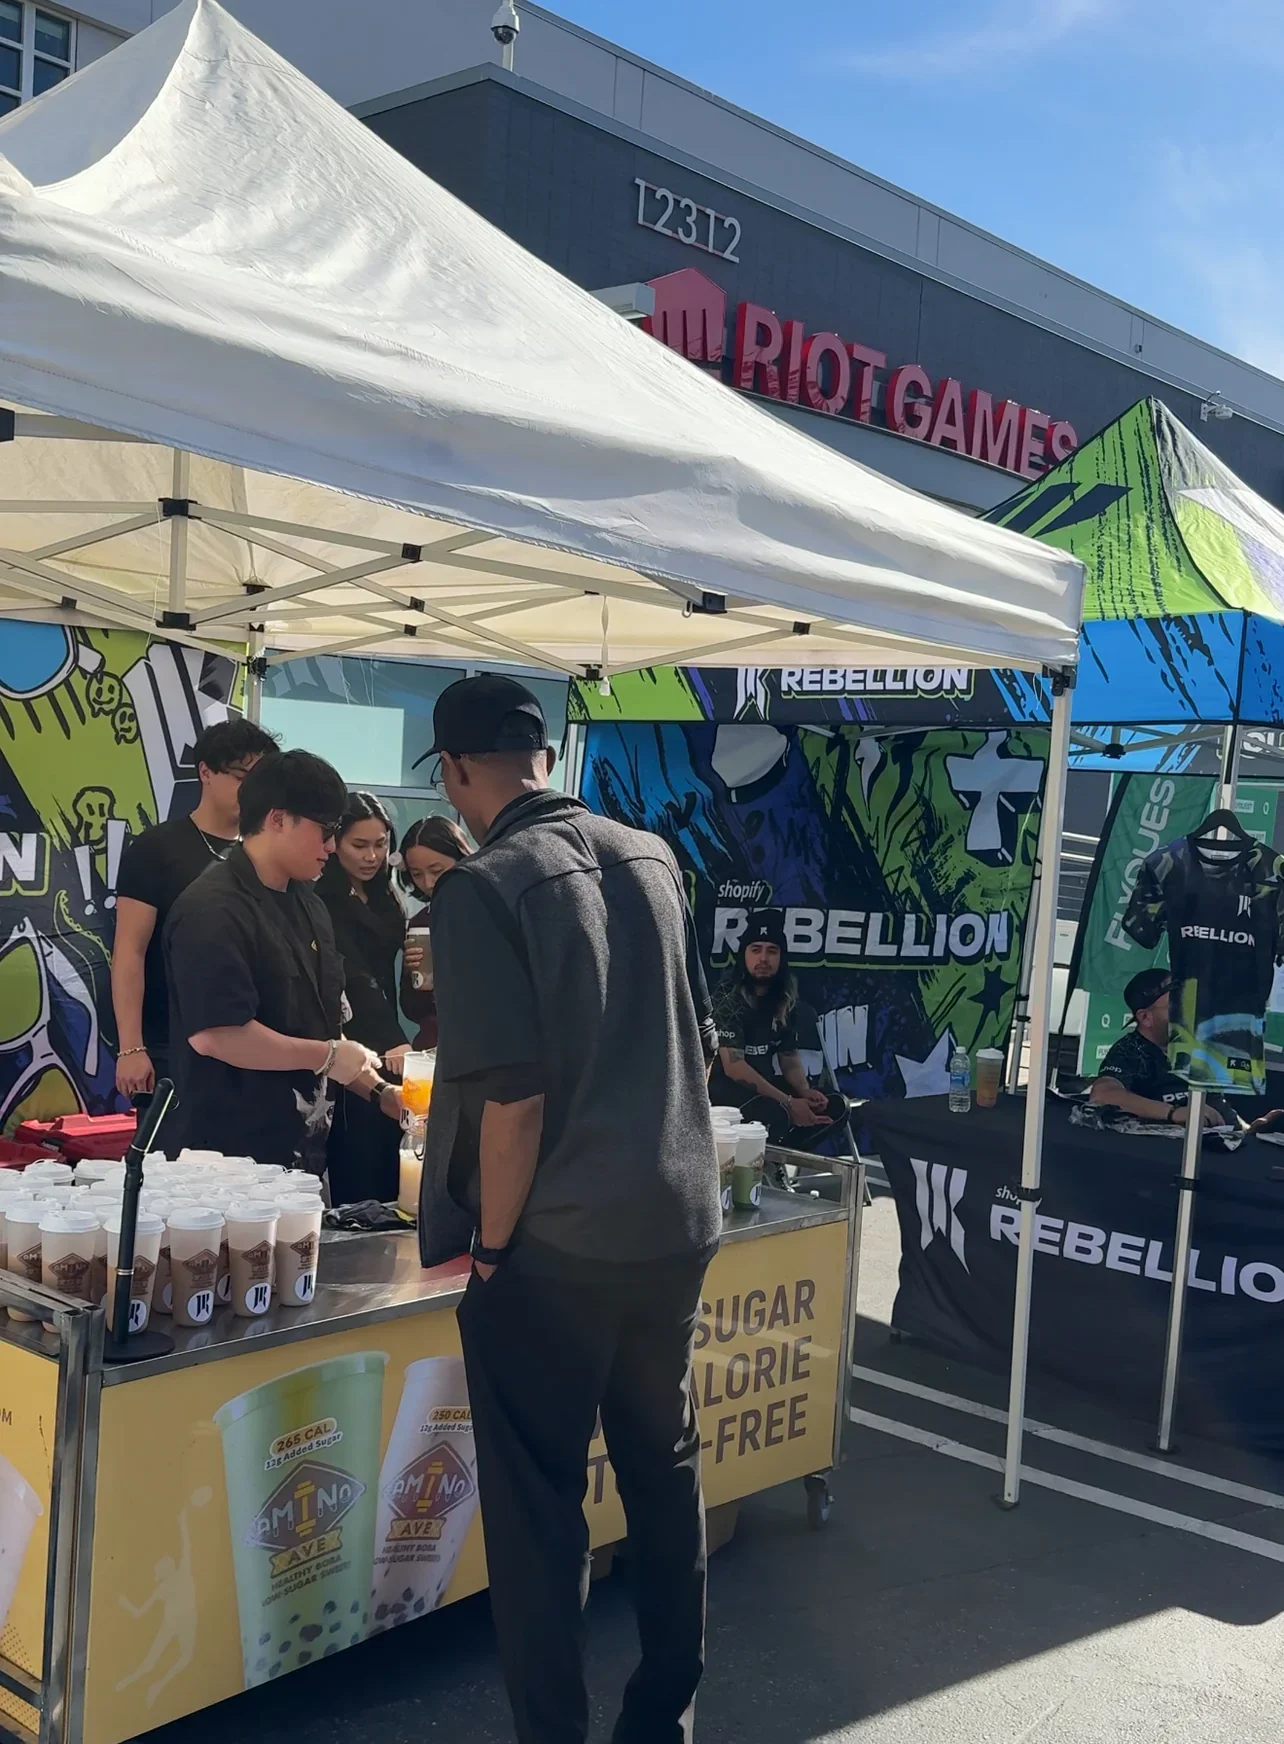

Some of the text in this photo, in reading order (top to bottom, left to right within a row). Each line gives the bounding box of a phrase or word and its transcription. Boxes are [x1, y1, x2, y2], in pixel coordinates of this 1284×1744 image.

[634, 177, 741, 264] 12312
[733, 301, 1079, 482] RIOT GAMES
[780, 668, 969, 692] REBELLION
[717, 879, 765, 903] shopify
[711, 906, 1008, 957] RBELLION
[694, 1279, 816, 1350] SUGAR
[432, 1411, 450, 1421] 250
[276, 1424, 331, 1453] 265 CAL
[283, 1443, 313, 1461] Added
[315, 1432, 342, 1448] Sugar
[400, 1521, 433, 1537] AVE
[287, 1537, 326, 1565] AVE
